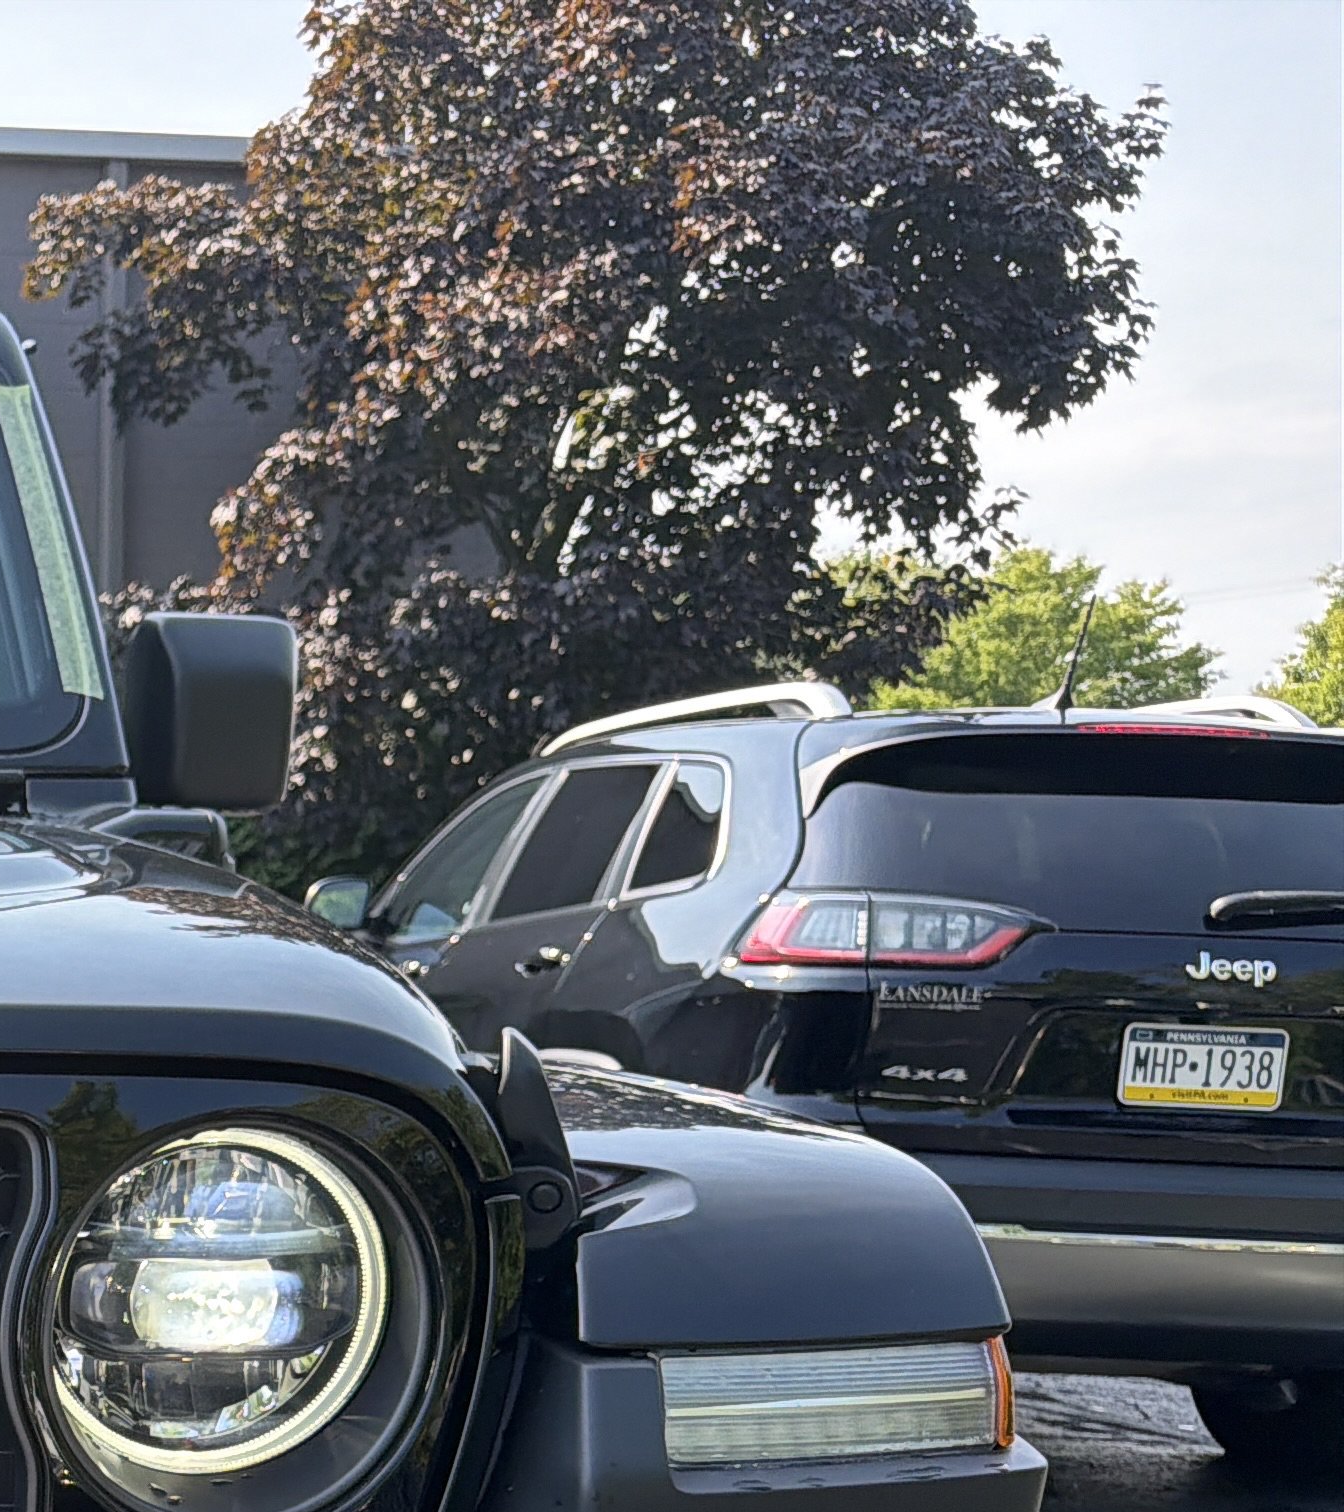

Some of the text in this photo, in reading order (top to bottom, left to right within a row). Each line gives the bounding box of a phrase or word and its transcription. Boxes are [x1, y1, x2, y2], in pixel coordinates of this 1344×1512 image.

[1185, 950, 1277, 988] Jeep
[879, 981, 983, 1003] LANSDALE
[1166, 1031, 1247, 1045] PENNSYLVANIA
[881, 1065, 968, 1082] 4x4
